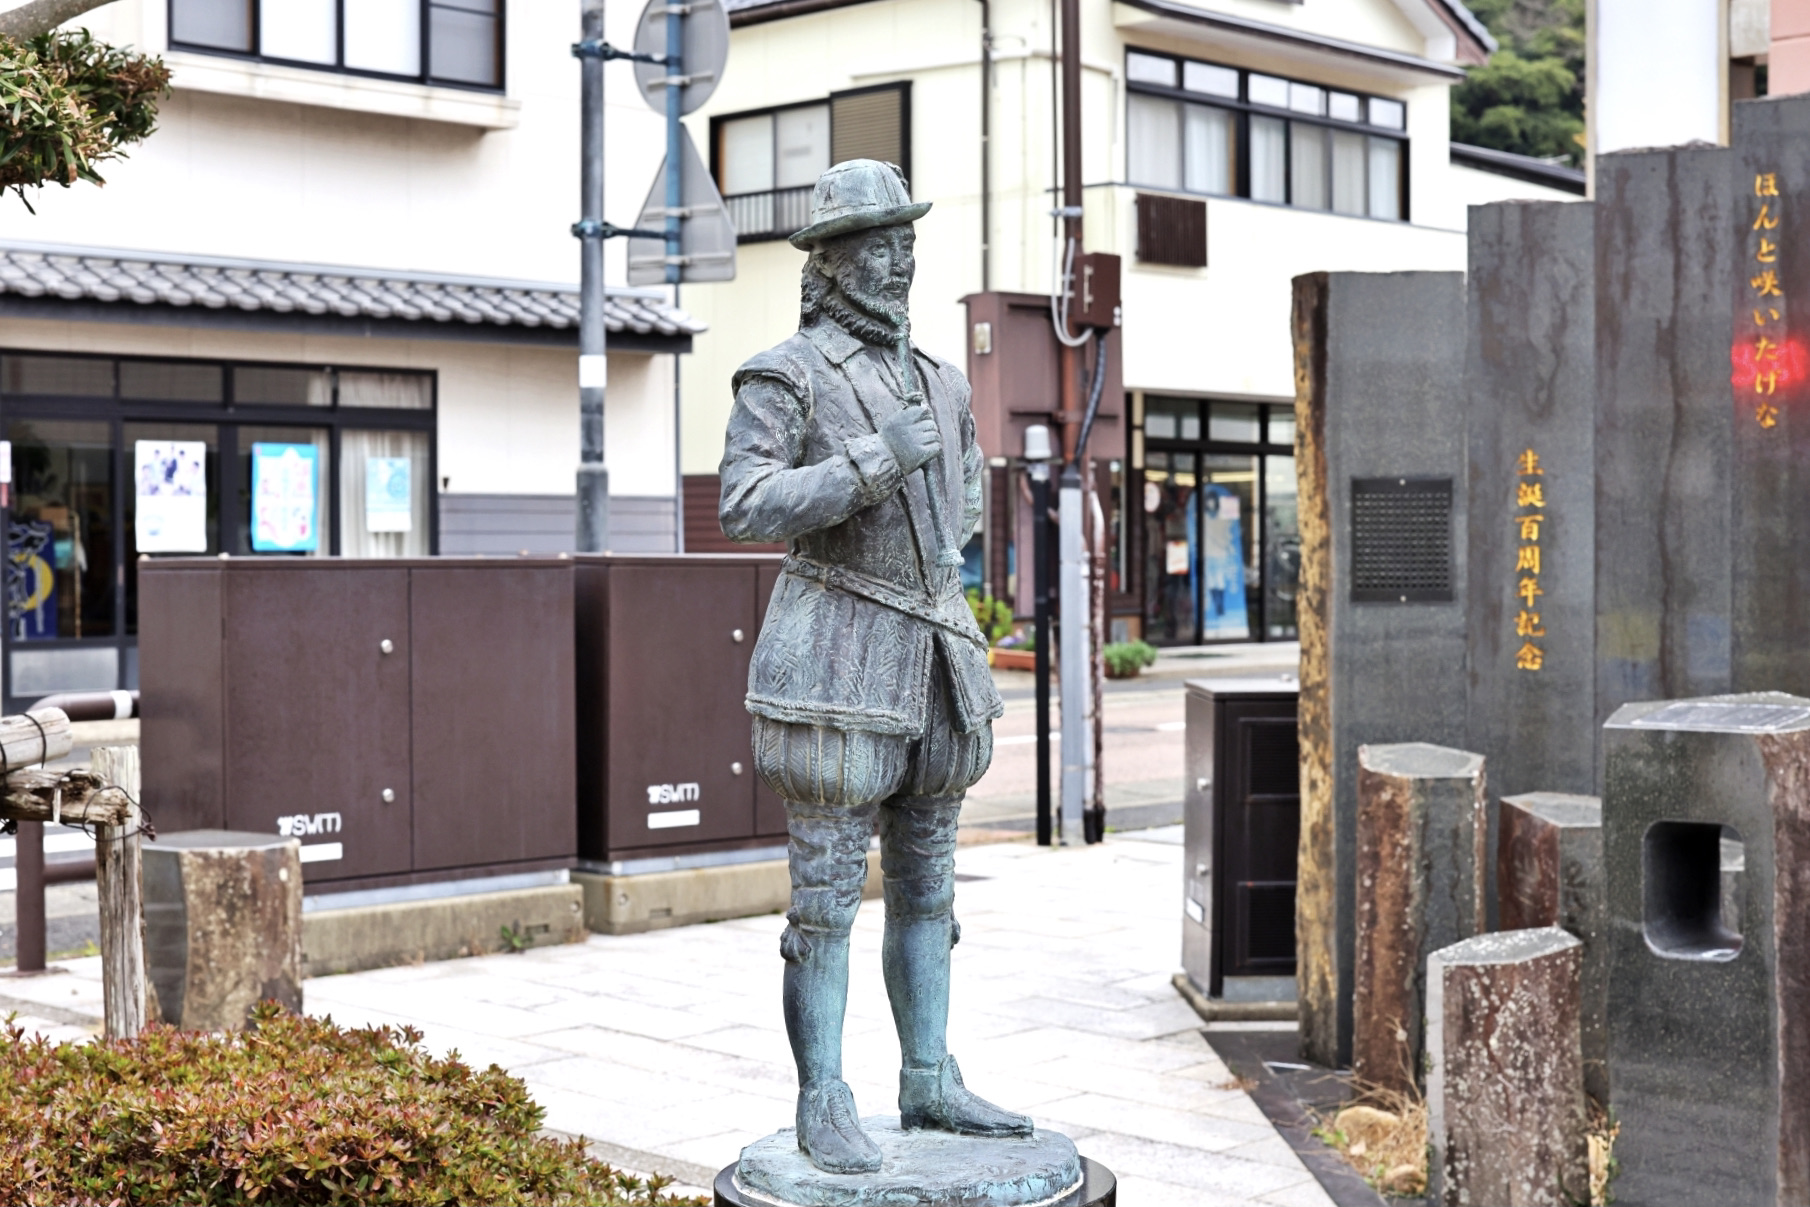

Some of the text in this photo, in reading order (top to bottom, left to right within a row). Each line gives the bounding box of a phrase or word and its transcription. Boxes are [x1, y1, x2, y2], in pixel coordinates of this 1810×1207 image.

[1751, 173, 1783, 428] ほんと咲いたげな
[1514, 448, 1547, 670] 生誕百周年記念
